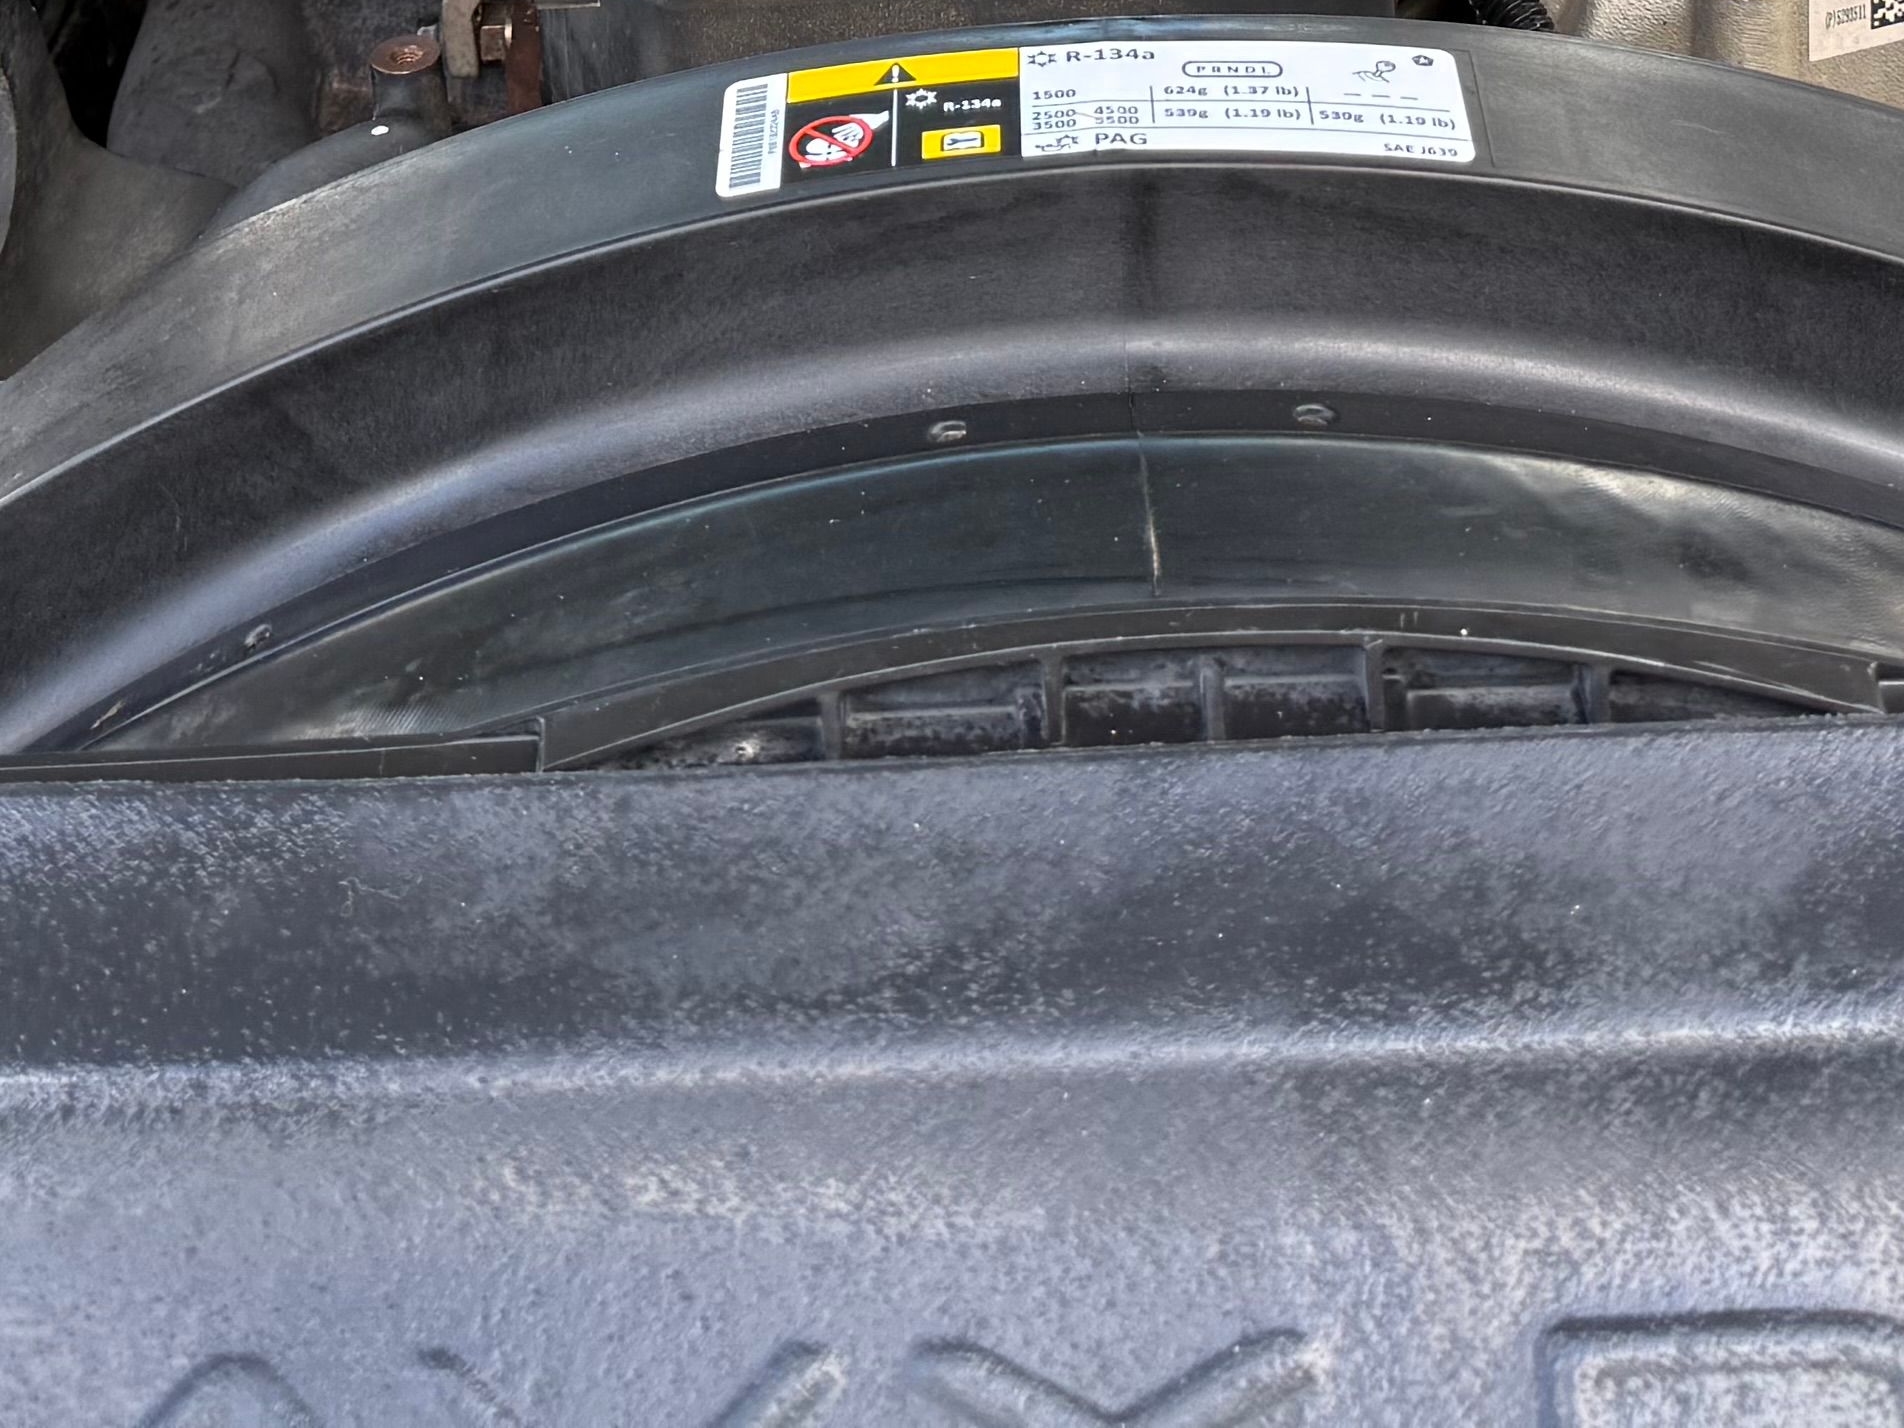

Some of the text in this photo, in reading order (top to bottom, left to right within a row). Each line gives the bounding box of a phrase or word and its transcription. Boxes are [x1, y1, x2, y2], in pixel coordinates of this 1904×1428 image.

[1065, 48, 1156, 63] R-134a
[1032, 89, 1077, 101] 1500
[1275, 85, 1300, 98] lb)
[944, 98, 1002, 112] R-134a
[1032, 106, 1139, 121] 2500 4500
[1277, 108, 1302, 121] lb)
[1432, 117, 1457, 131] lb)
[1032, 118, 1077, 131] 3500
[1095, 133, 1148, 145] PAG
[1384, 143, 1415, 154] SAE
